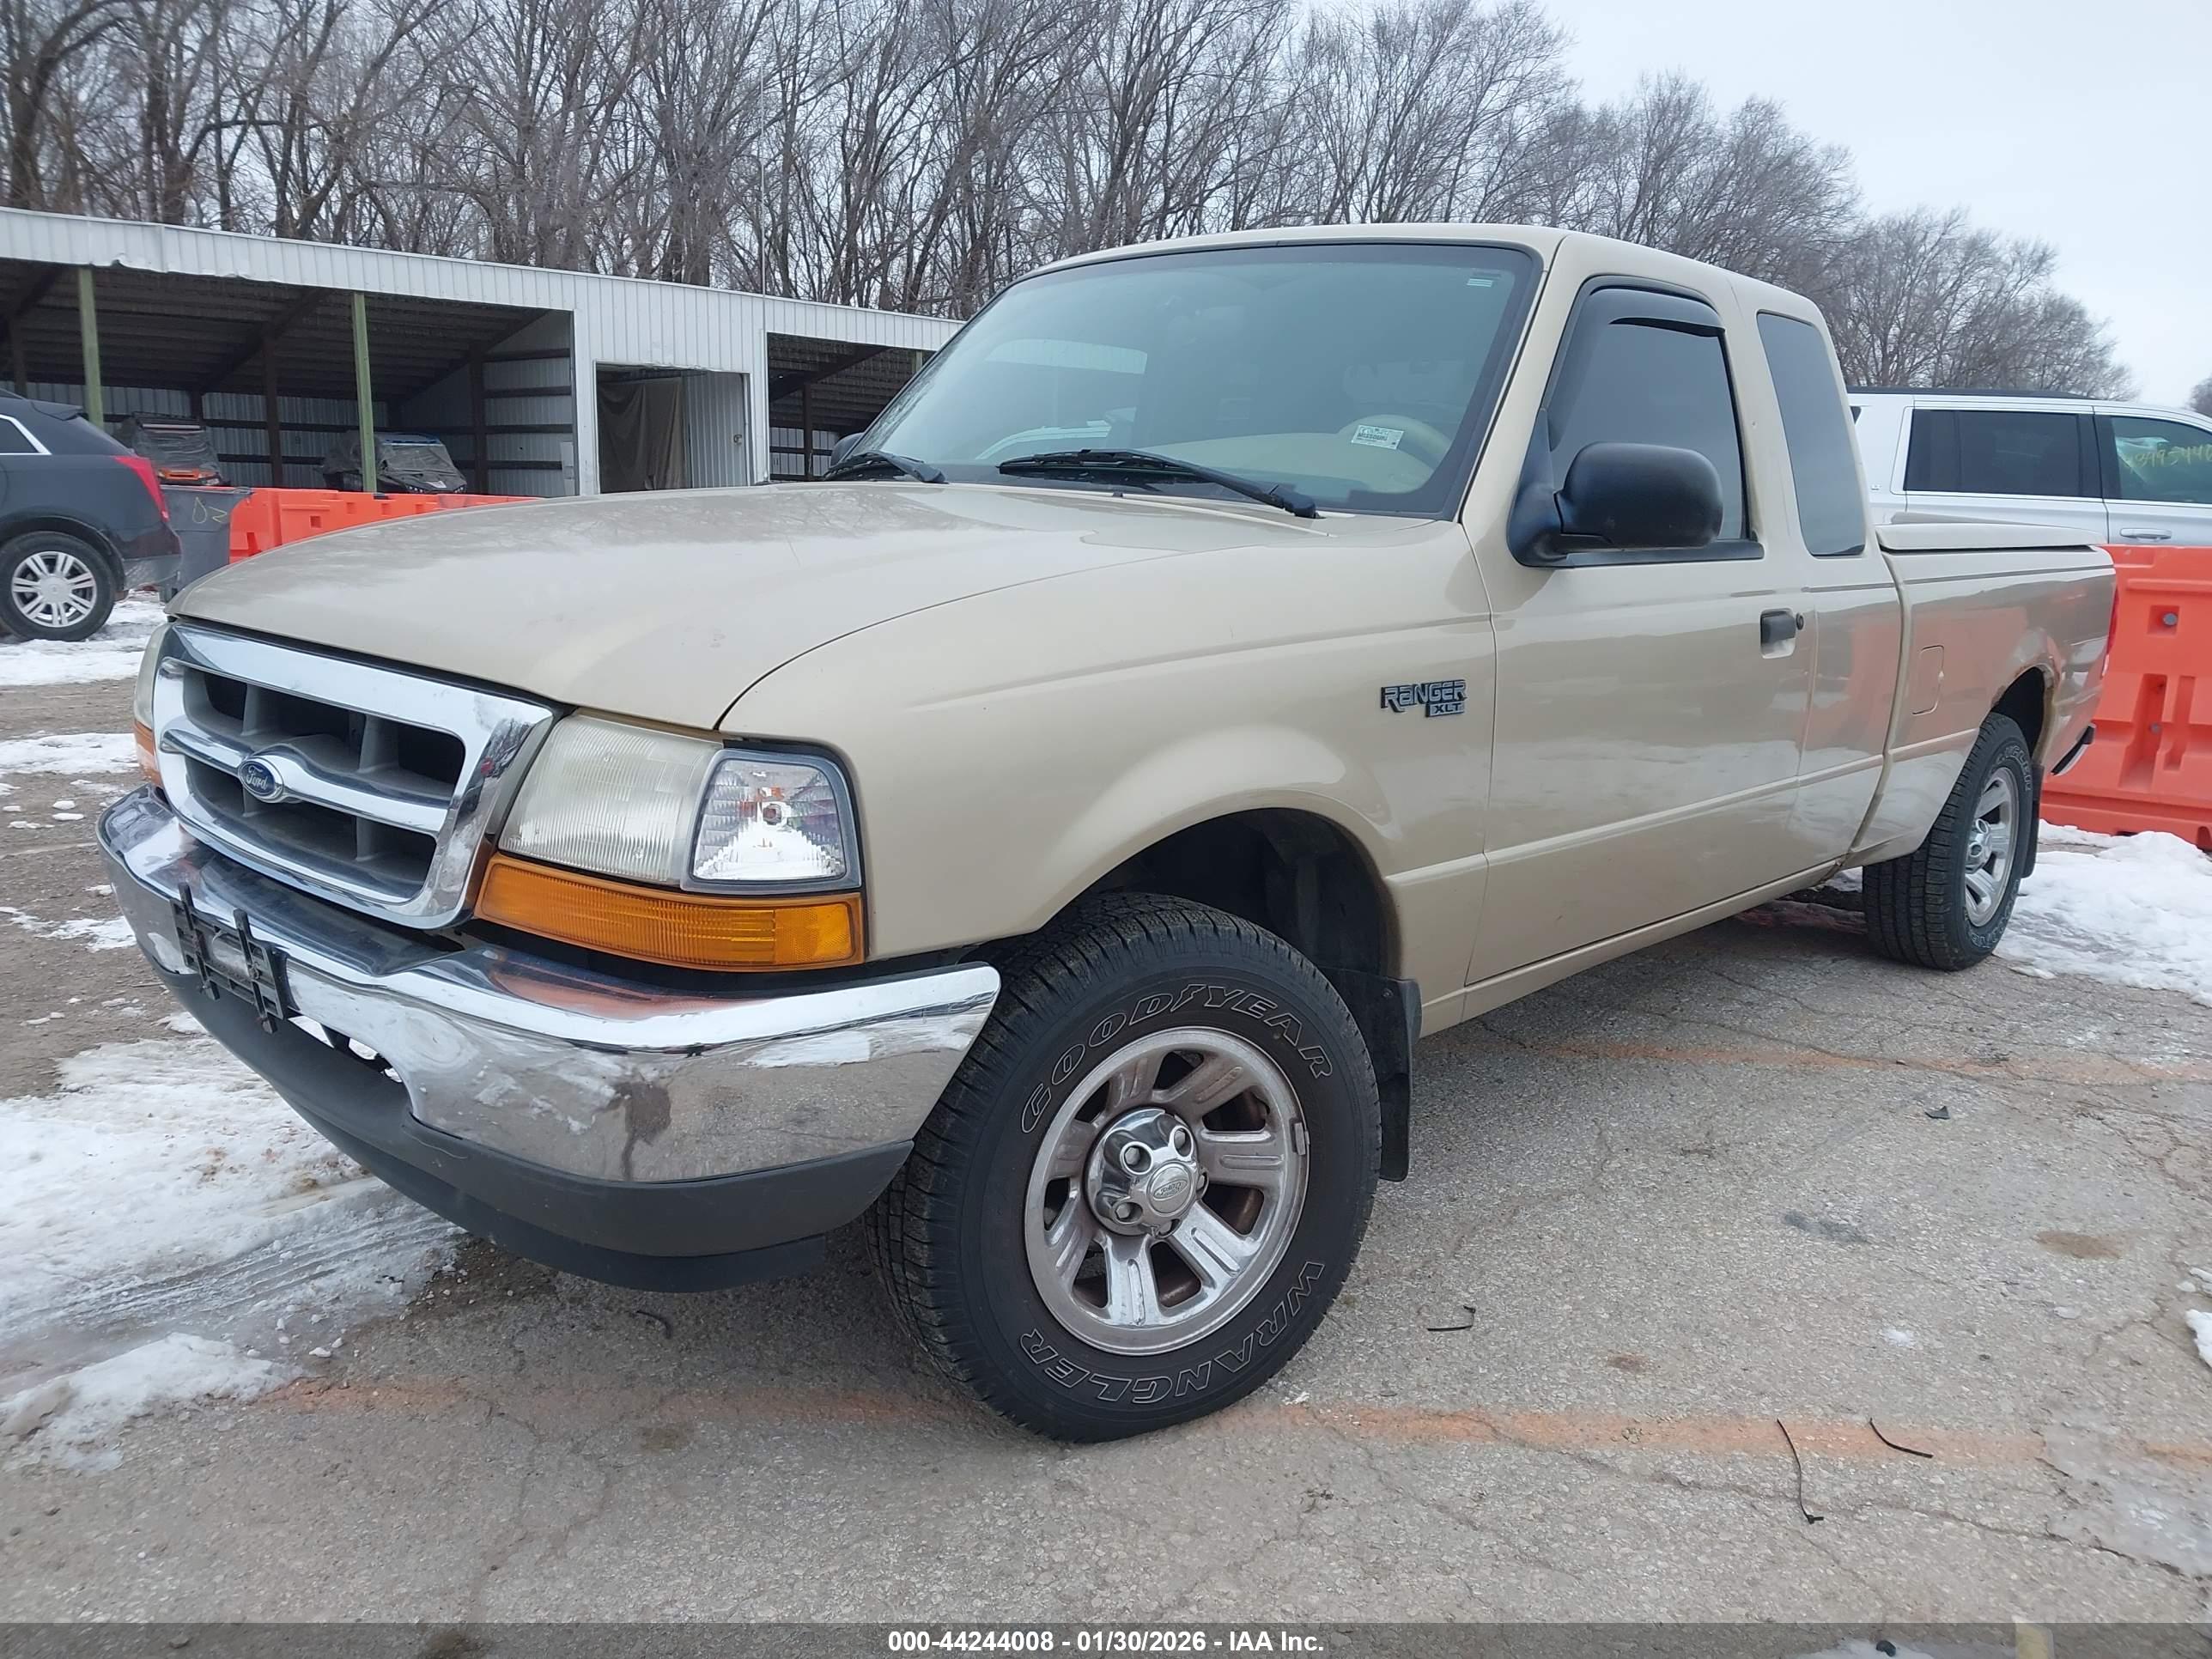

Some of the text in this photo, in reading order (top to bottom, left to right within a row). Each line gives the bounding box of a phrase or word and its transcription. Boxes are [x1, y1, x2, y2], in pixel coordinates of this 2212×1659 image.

[1381, 679, 1467, 712] RANGER
[1435, 703, 1461, 714] XLT
[245, 765, 268, 789] Ford
[1022, 984, 1332, 1133] GOODYEAR
[1020, 1261, 1325, 1403] WRANGLER
